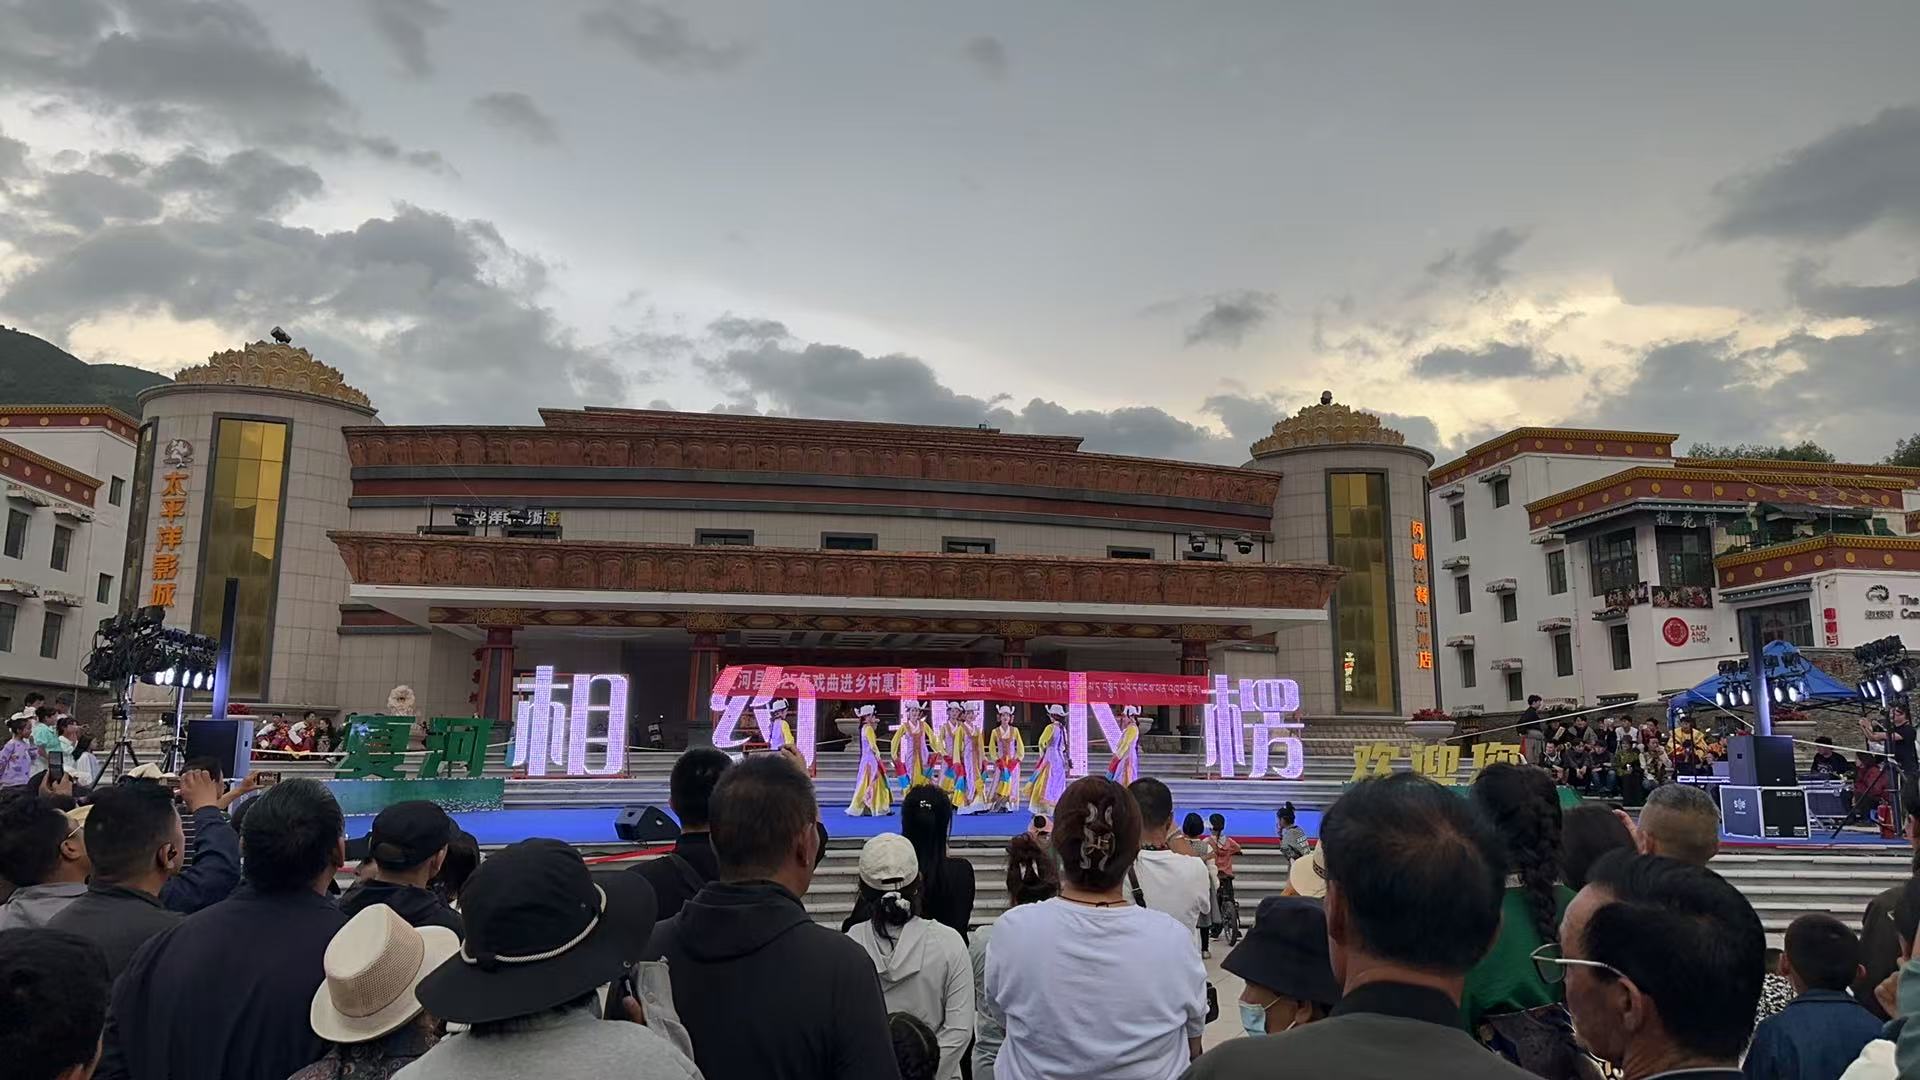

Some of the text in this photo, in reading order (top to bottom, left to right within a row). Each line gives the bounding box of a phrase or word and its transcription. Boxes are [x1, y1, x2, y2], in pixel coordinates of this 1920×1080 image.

[151, 471, 189, 608] 太平洋影城
[1898, 594, 1919, 605] The
[335, 714, 495, 779] 夏河
